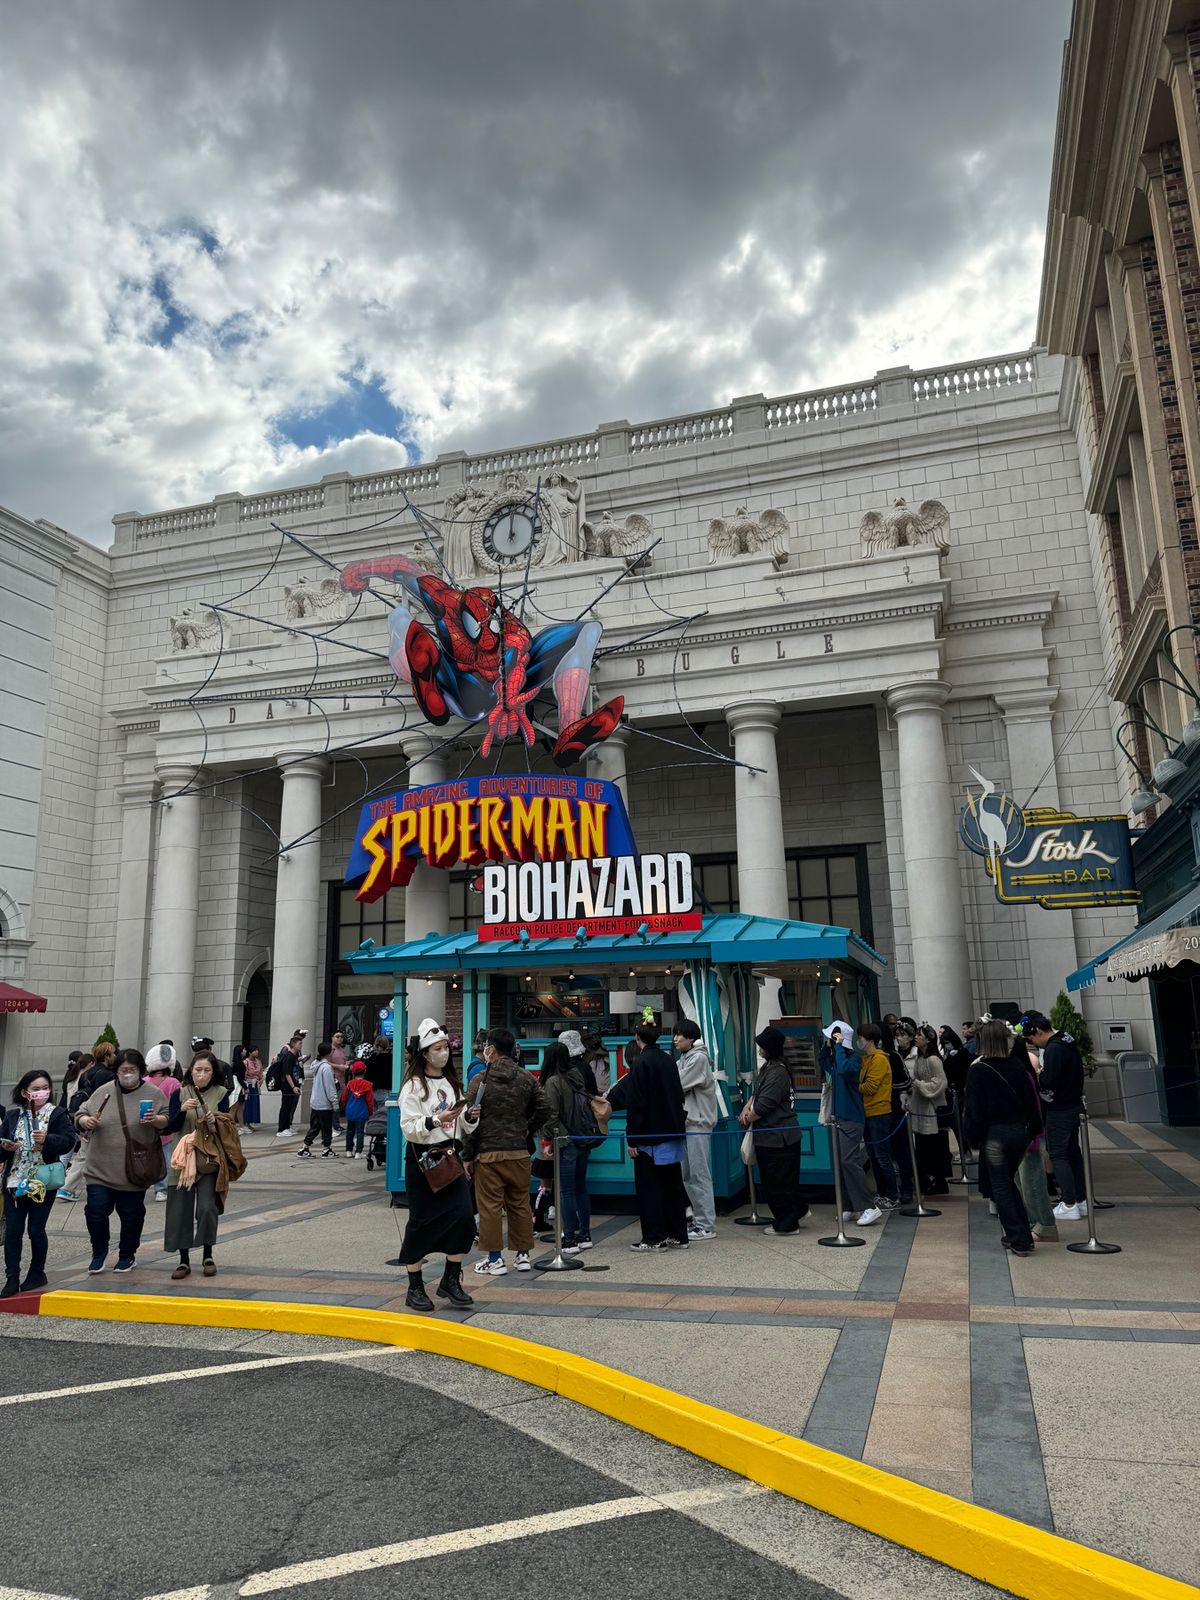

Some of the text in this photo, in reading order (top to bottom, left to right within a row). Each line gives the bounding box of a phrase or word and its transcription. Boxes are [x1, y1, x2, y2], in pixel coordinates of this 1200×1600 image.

[229, 634, 834, 723] DAILY BUGLE
[370, 777, 604, 820] THE AMAZING ADVENTURES OF
[355, 796, 608, 902] SPIDER-MAN
[1004, 827, 1119, 868] Stork
[484, 852, 694, 924] BIOHAZARD
[1063, 868, 1112, 882] BAR
[535, 923, 563, 935] POLICE
[1183, 936, 1200, 950] 20
